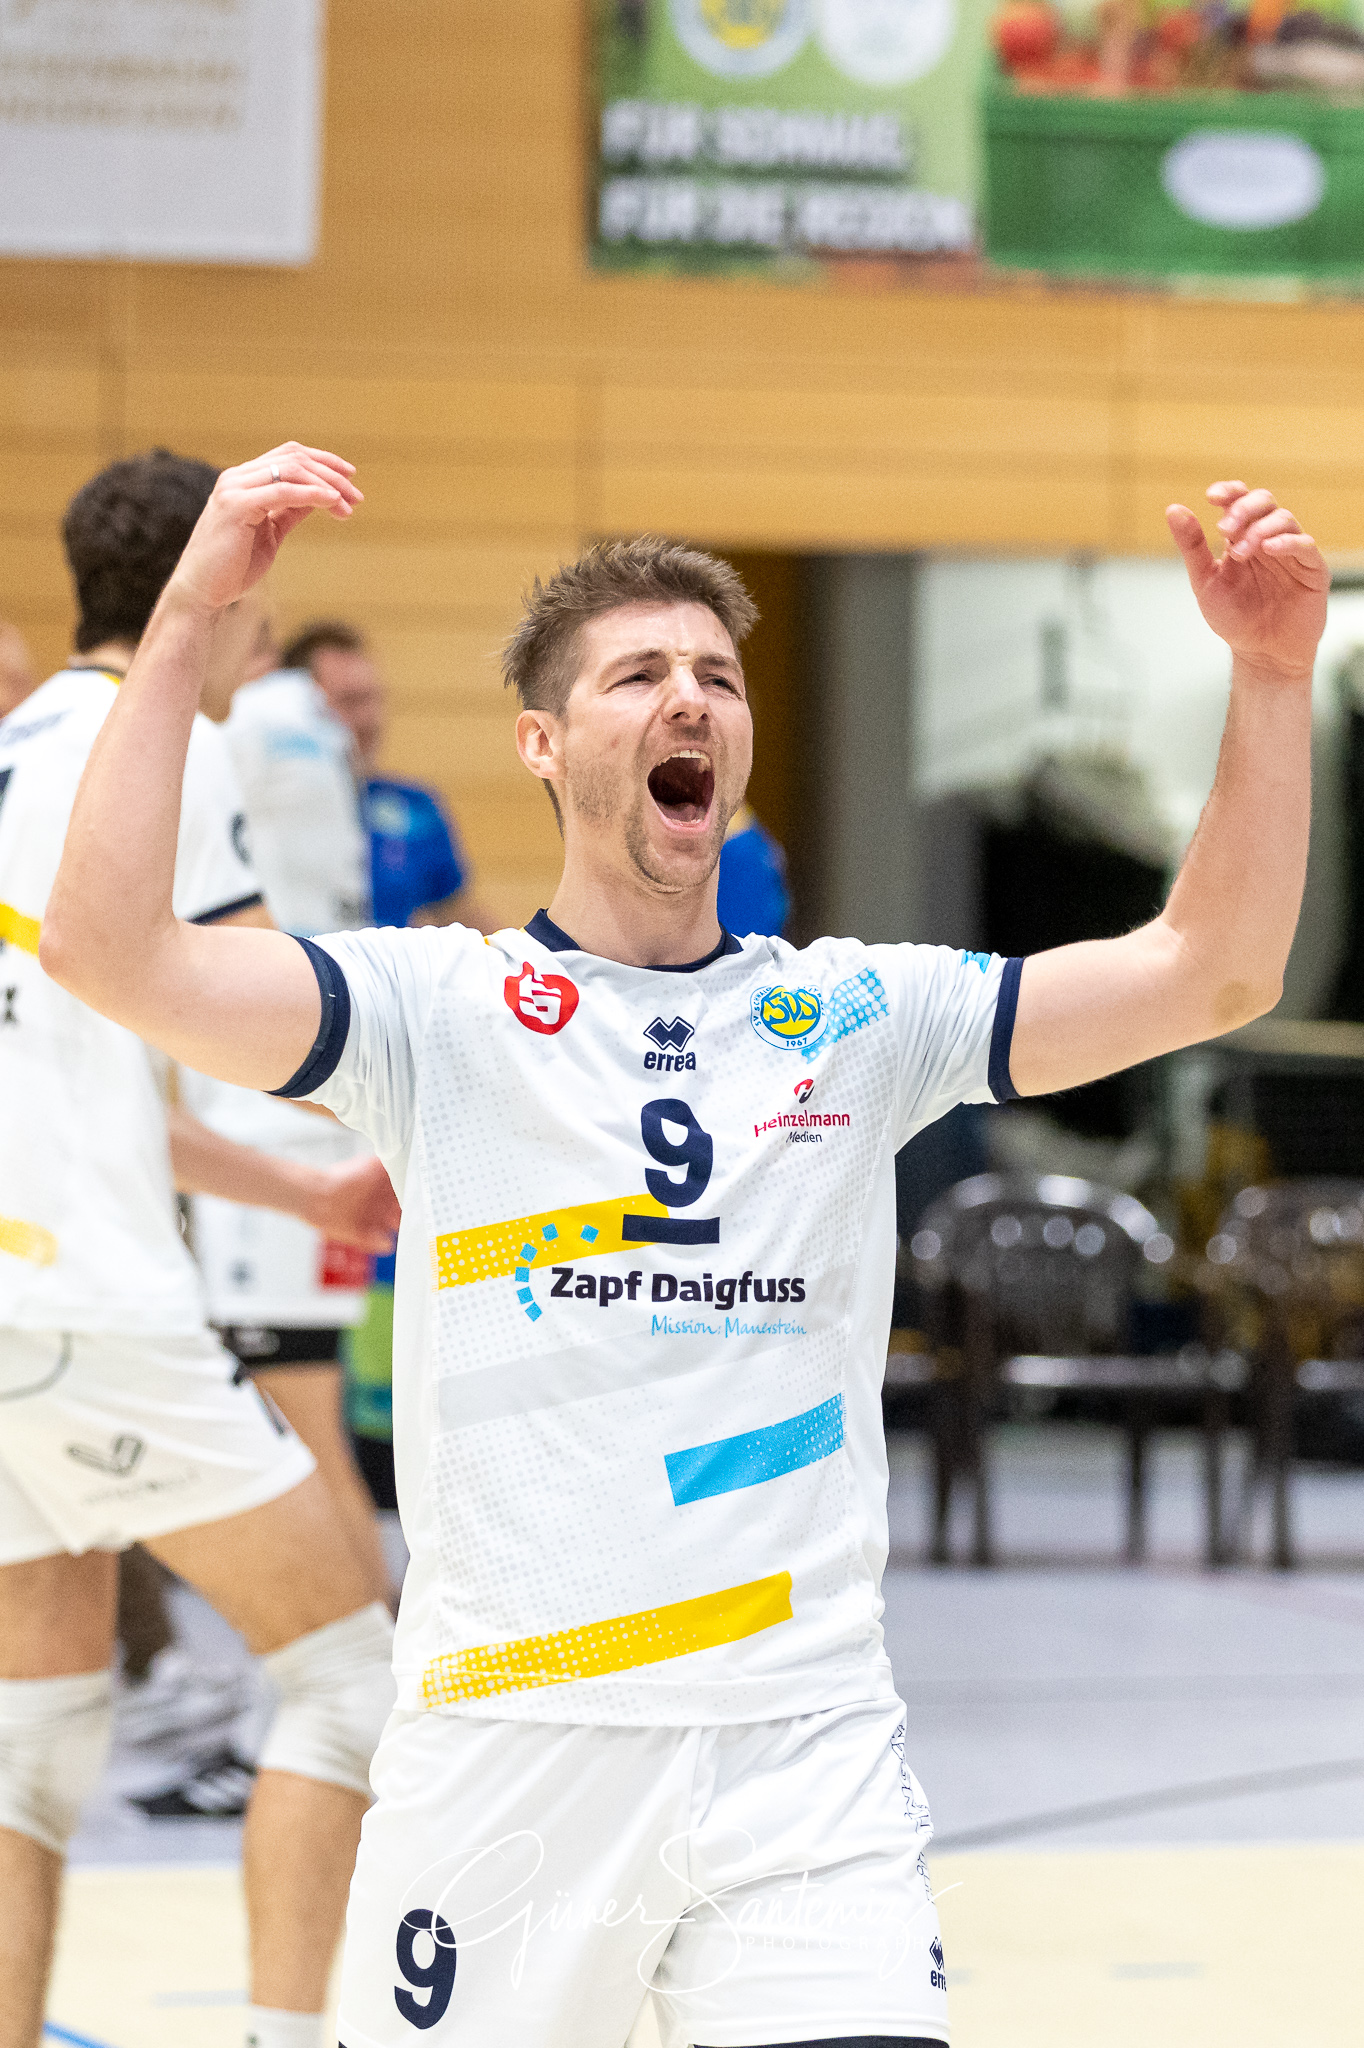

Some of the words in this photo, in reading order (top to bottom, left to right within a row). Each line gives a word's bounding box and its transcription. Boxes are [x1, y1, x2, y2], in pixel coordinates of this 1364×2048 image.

[786, 1037, 807, 1047] 1967
[754, 1110, 850, 1137] Heinzelmann
[786, 1131, 822, 1143] Medien
[641, 1098, 713, 1207] 9
[550, 1267, 642, 1307] Zapf
[651, 1271, 806, 1310] Daigfuss
[651, 1314, 722, 1336] Mission:
[394, 1908, 457, 2029] 9
